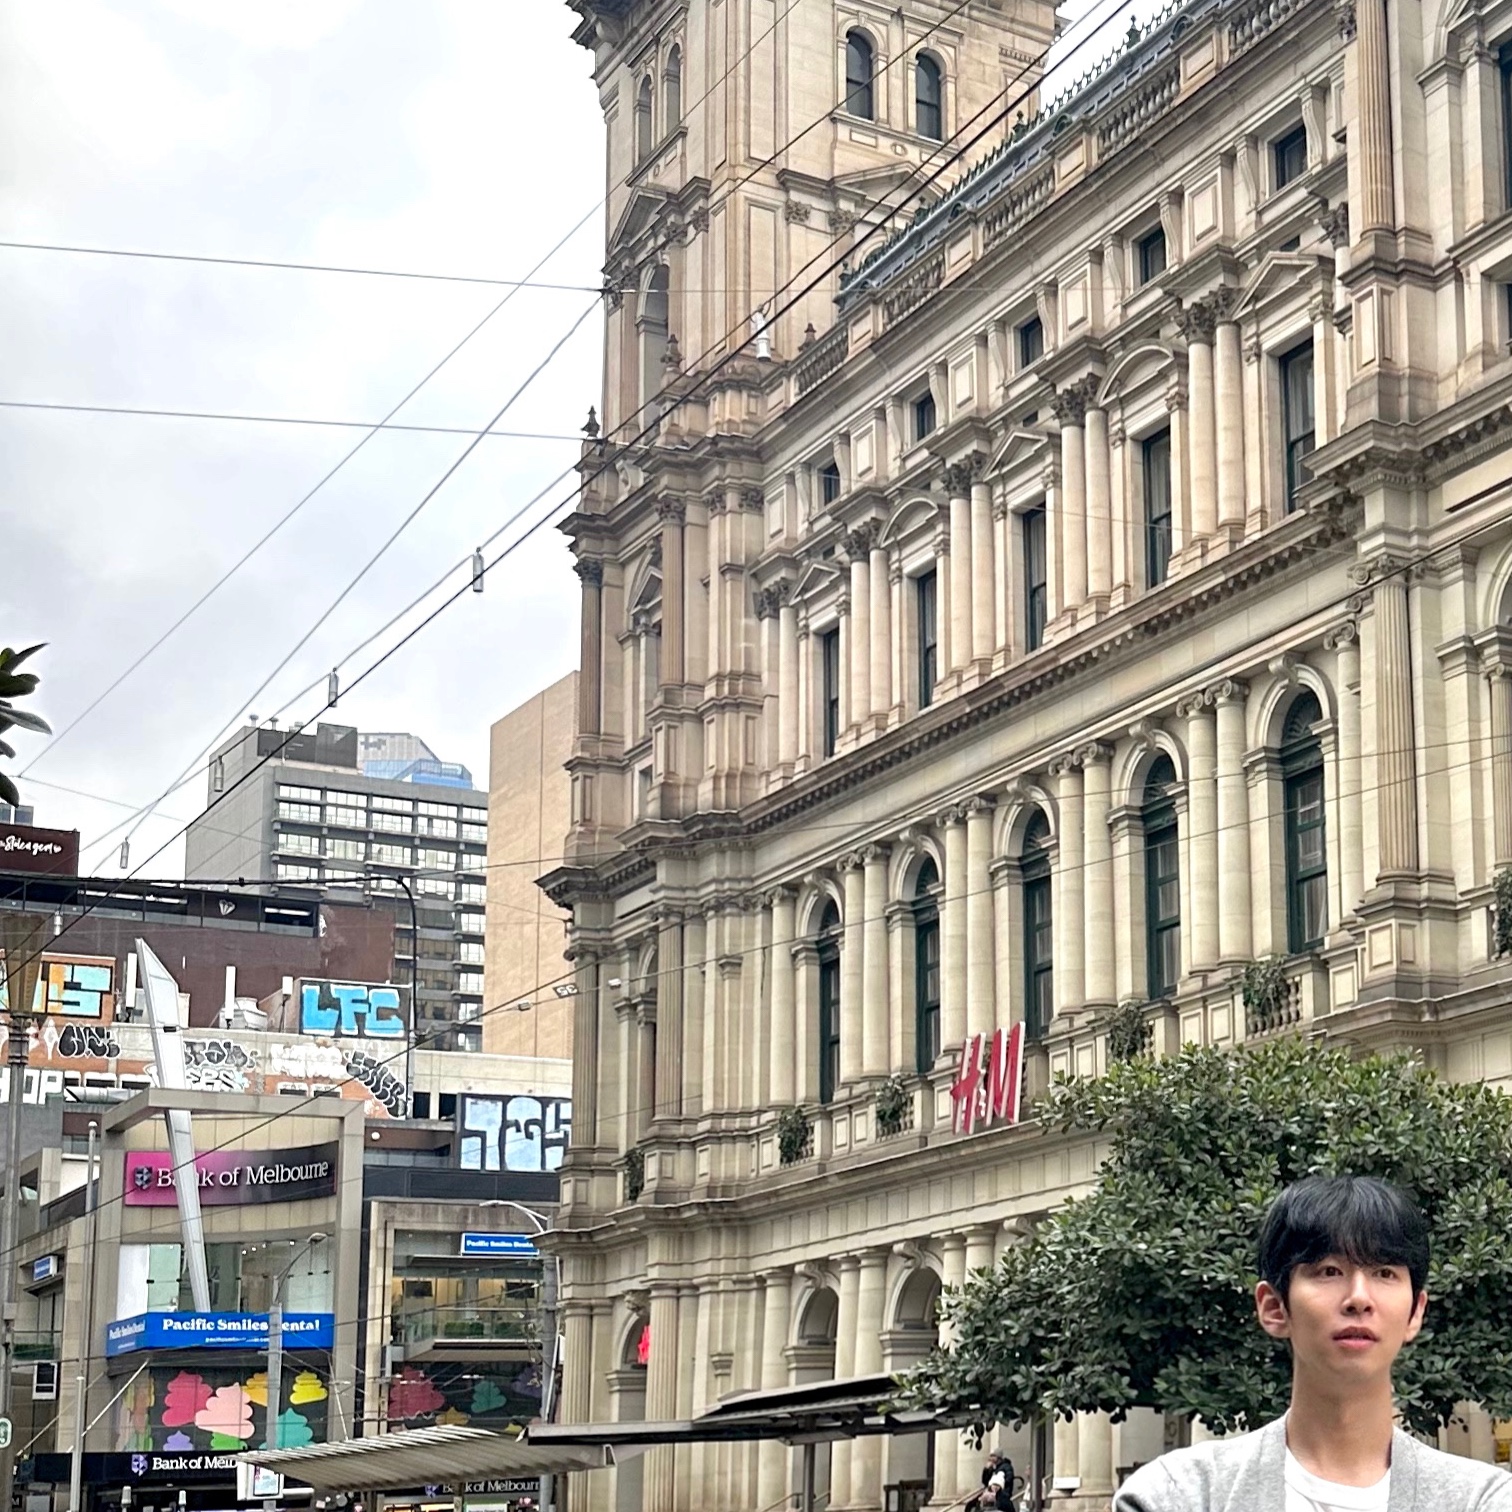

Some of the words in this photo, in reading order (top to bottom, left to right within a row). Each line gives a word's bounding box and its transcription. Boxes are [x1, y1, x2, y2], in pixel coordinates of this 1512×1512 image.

[302, 984, 405, 1037] LFC
[157, 1168, 214, 1187] Bk
[219, 1166, 240, 1187] of
[246, 1161, 329, 1186] Melbourne
[163, 1318, 215, 1331] Pacific
[217, 1318, 268, 1331] Smiles
[282, 1319, 320, 1331] ental
[152, 1456, 188, 1470] Bank
[188, 1456, 202, 1469] of
[442, 1481, 474, 1494] Bak
[473, 1481, 486, 1493] of
